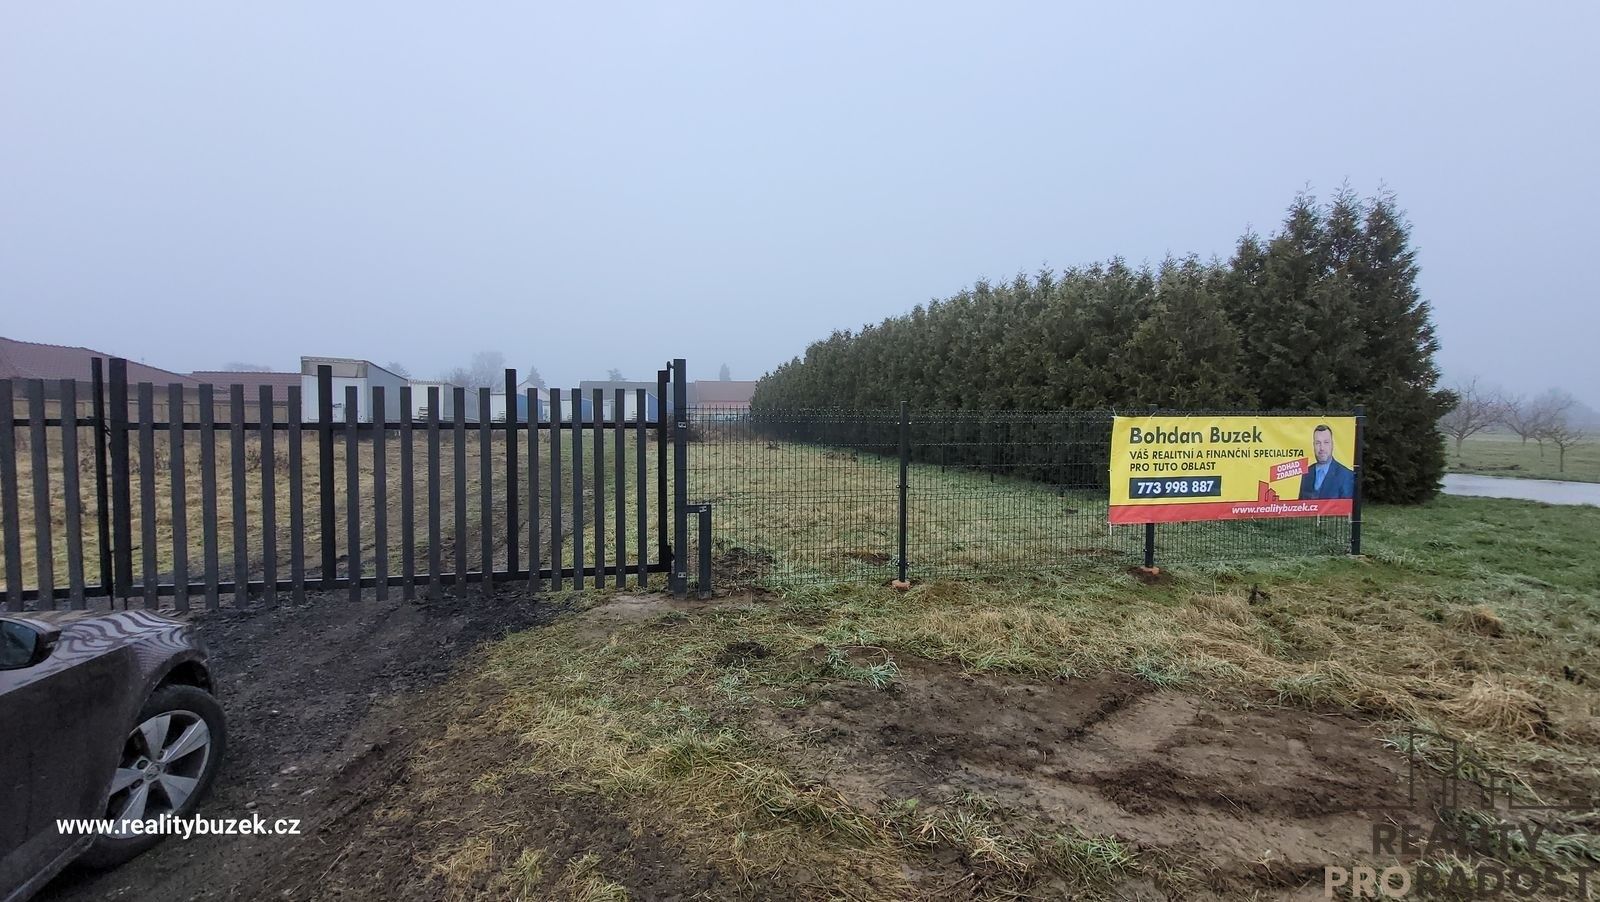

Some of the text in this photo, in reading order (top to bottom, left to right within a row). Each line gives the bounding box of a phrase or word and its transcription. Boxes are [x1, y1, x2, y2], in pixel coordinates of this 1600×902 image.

[1129, 426, 1263, 444] Bohdan Buzek
[1129, 447, 1304, 460] VÁŠ REALITNÍ A FINANČNÍ SPECIALISTA
[1129, 461, 1216, 472] PRO TUTO OBLAST
[1276, 461, 1300, 473] ODHAD
[1276, 468, 1303, 480] ZDARMA
[1137, 480, 1214, 494] 773 998 887
[1231, 503, 1319, 515] www.realitybuzek.cz
